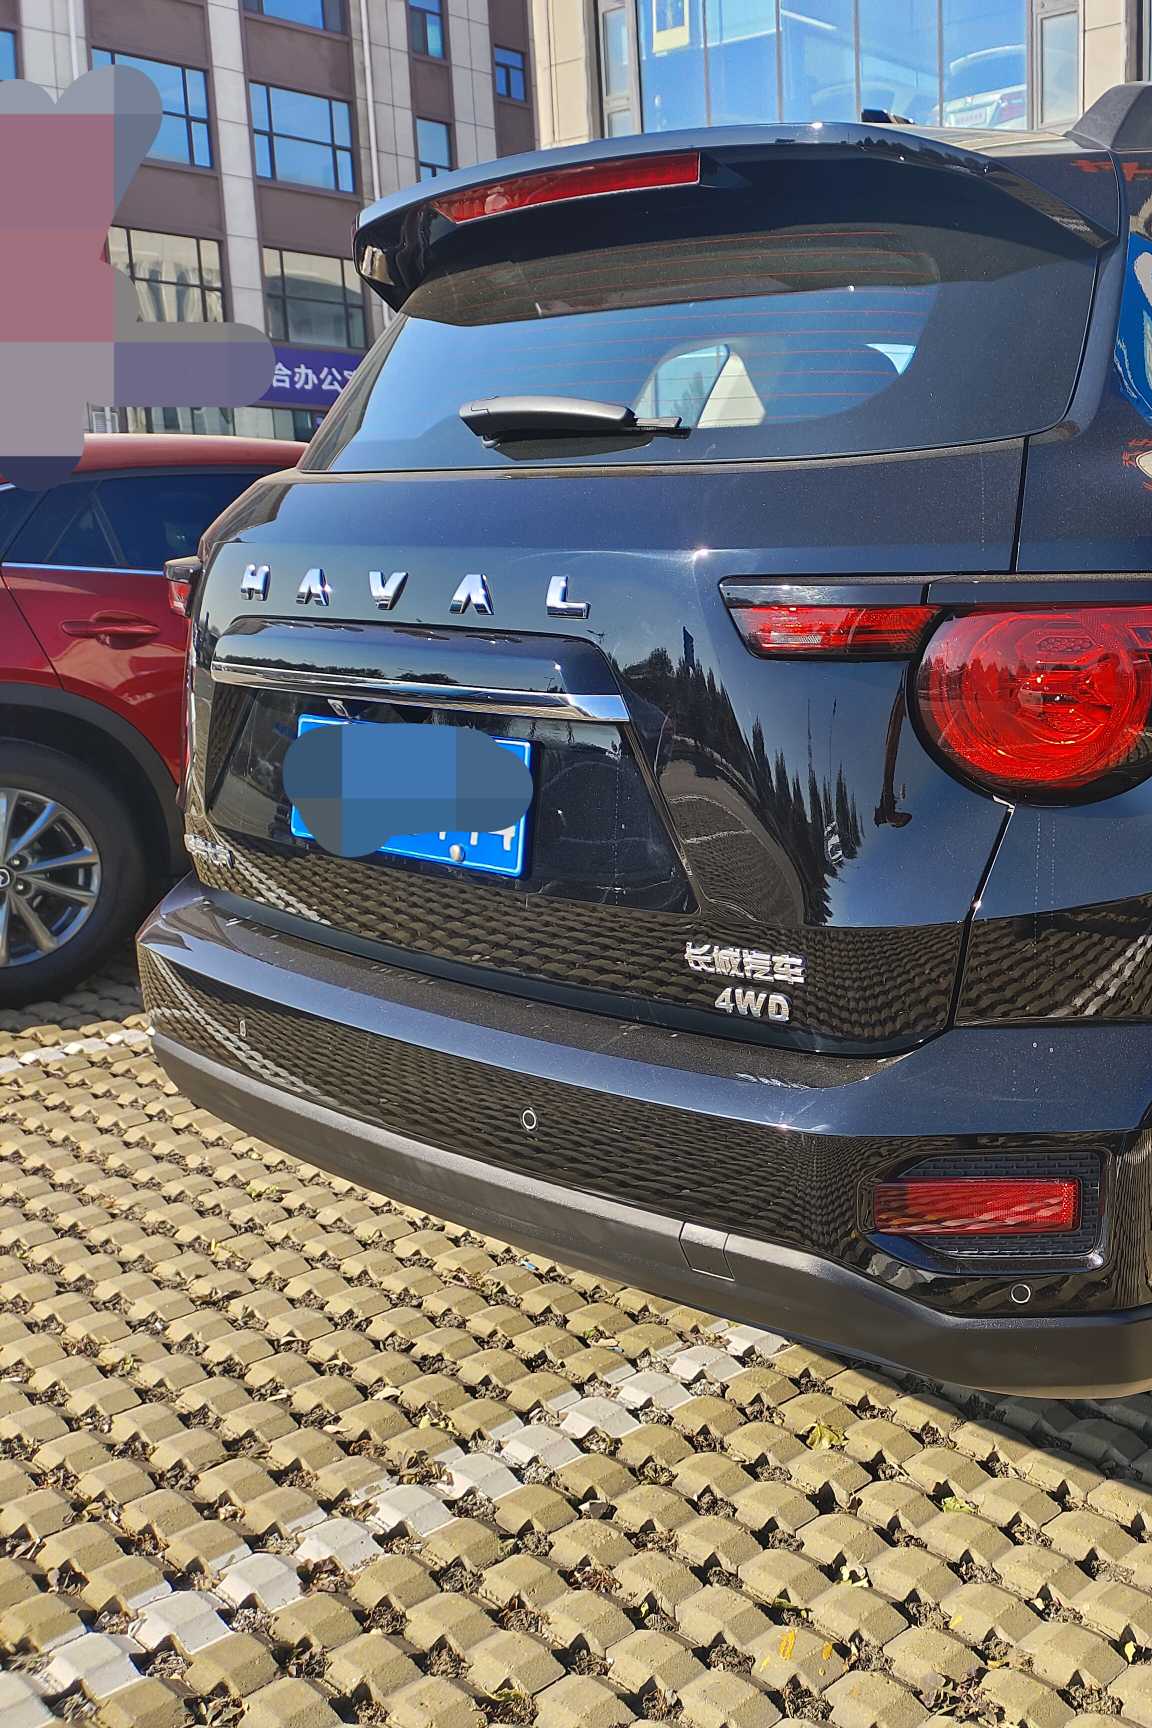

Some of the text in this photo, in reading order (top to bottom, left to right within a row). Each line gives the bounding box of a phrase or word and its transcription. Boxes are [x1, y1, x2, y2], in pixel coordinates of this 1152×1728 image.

[239, 563, 592, 620] HAVAL
[684, 941, 807, 985] 长城汽车
[714, 986, 792, 1022] 4WD
